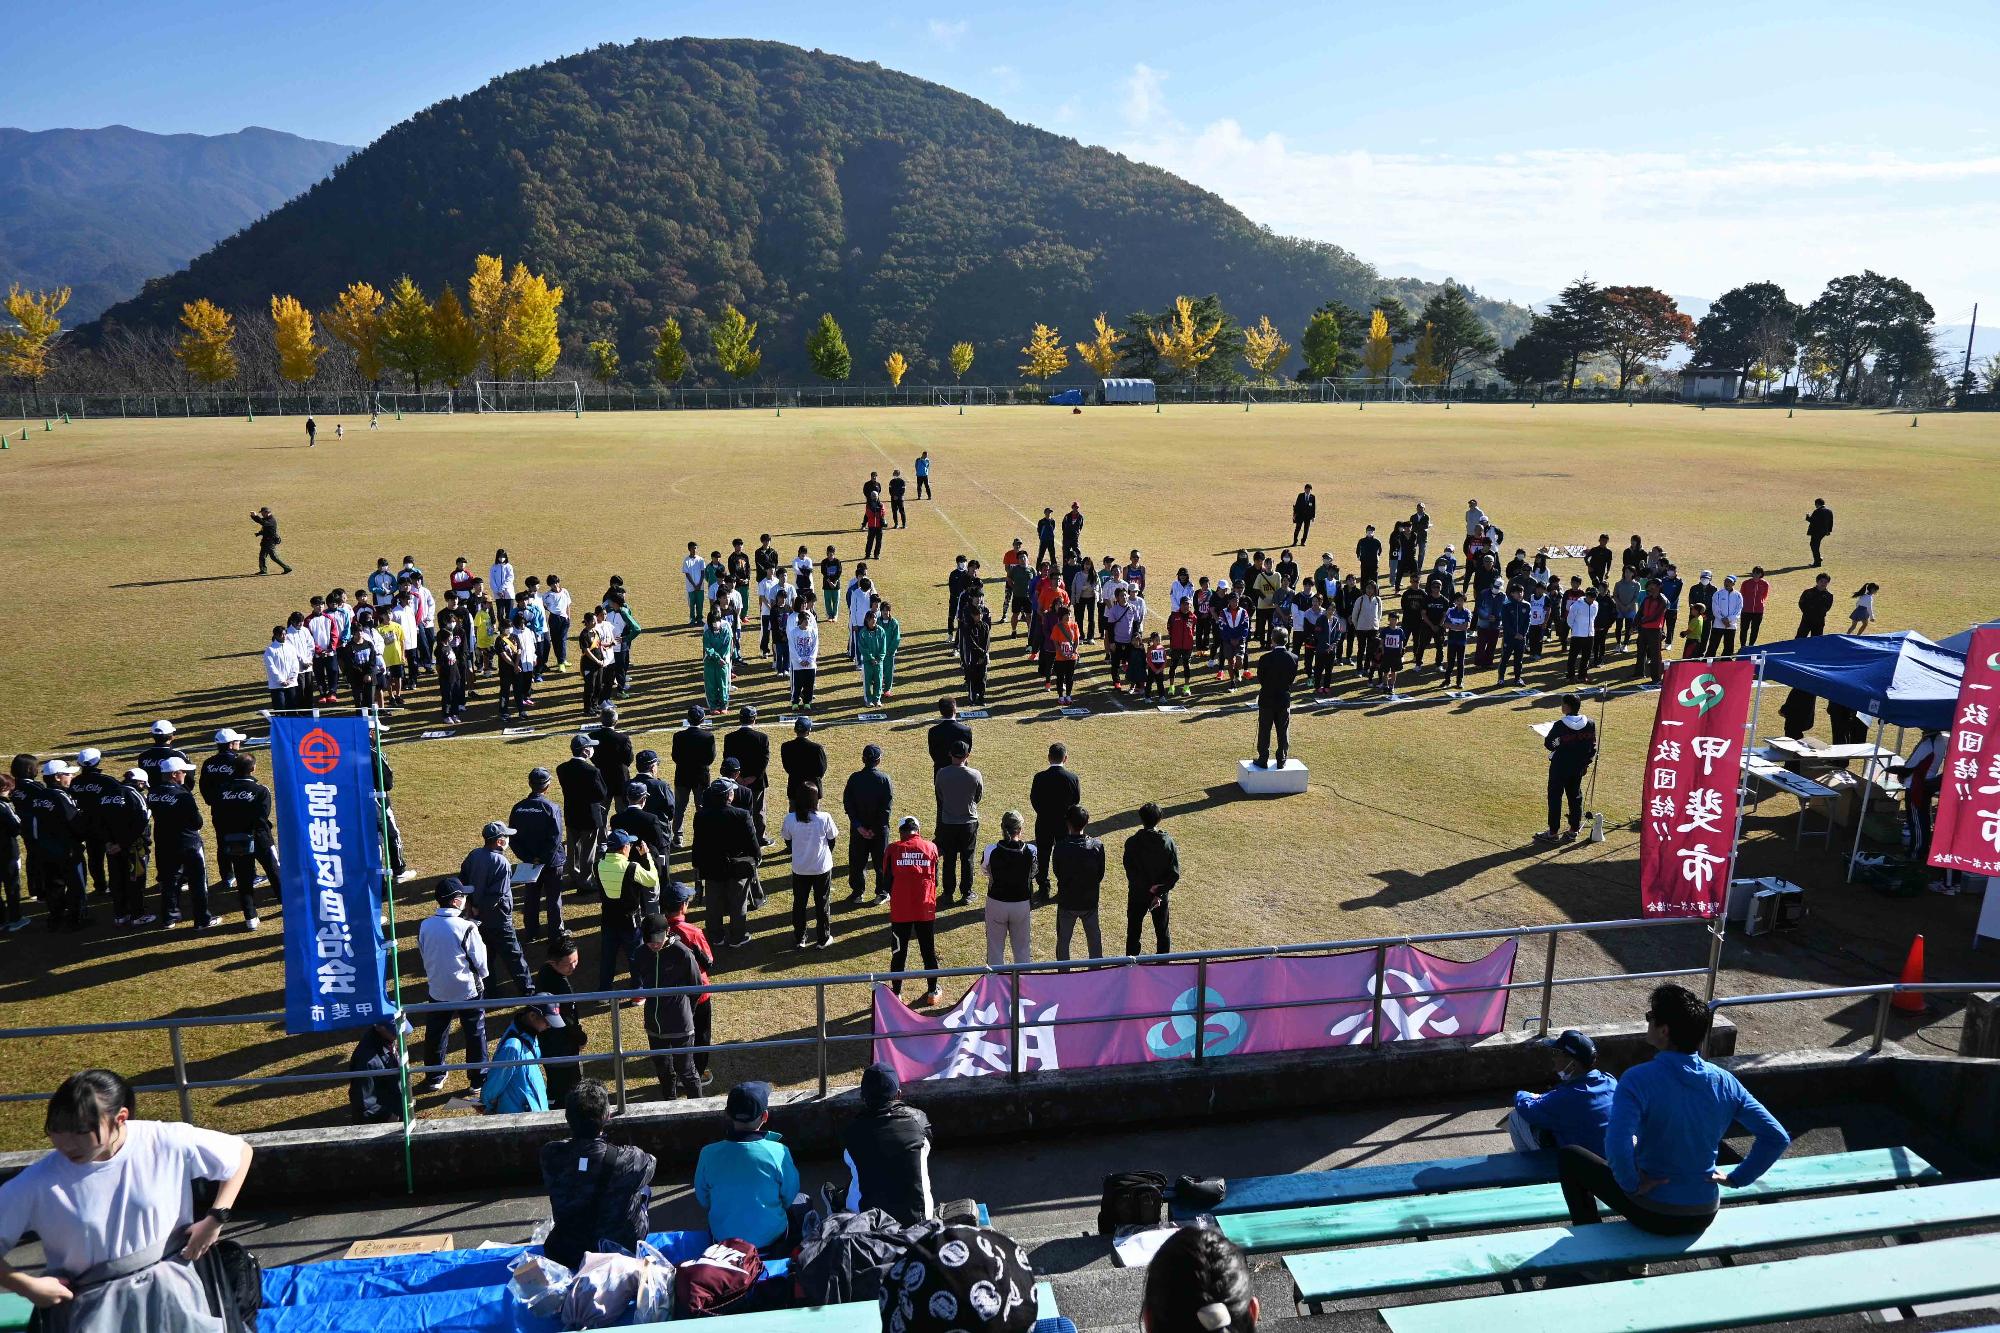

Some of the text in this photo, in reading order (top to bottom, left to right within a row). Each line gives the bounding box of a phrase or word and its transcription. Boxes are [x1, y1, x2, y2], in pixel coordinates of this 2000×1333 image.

[207, 764, 235, 775] Kai City
[85, 783, 103, 793] City
[148, 793, 178, 805] Kai City
[222, 790, 256, 801] Kai City
